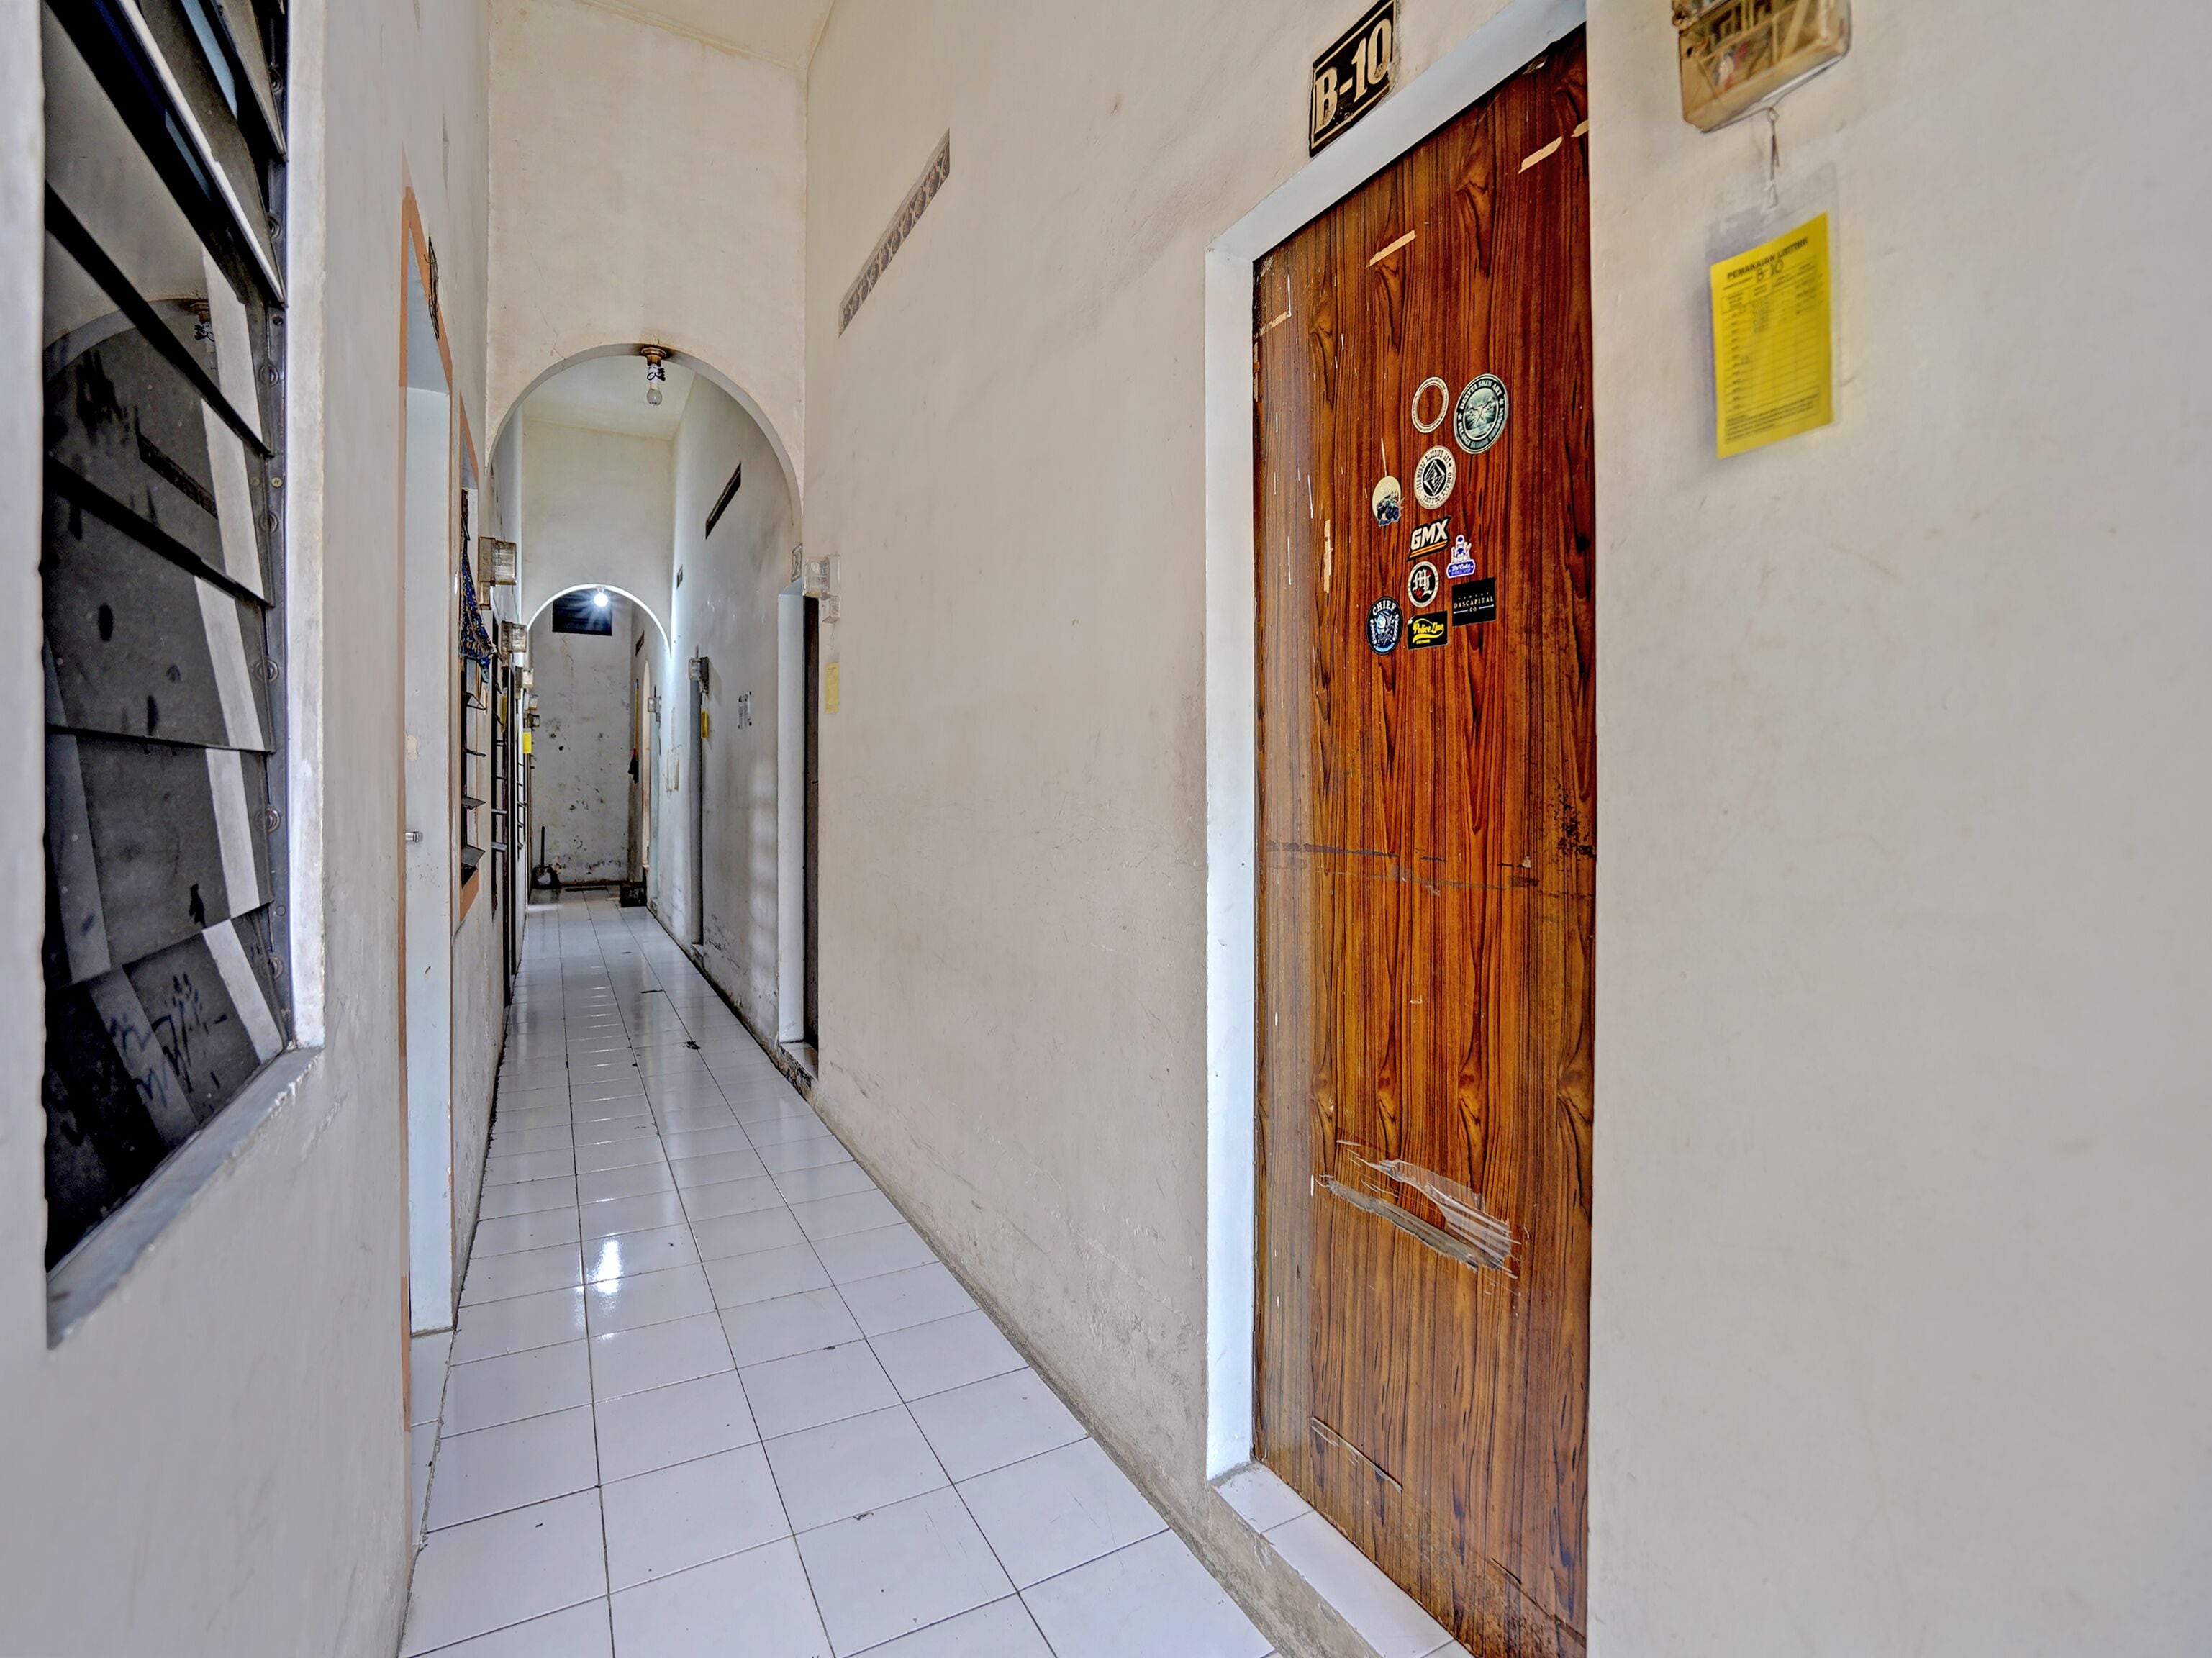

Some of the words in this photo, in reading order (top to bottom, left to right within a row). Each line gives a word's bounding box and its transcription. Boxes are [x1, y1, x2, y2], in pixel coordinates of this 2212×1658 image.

[1314, 18, 1392, 135] B-10
[1410, 518, 1448, 551] GMX
[1454, 596, 1494, 609] DASCAPITAL
